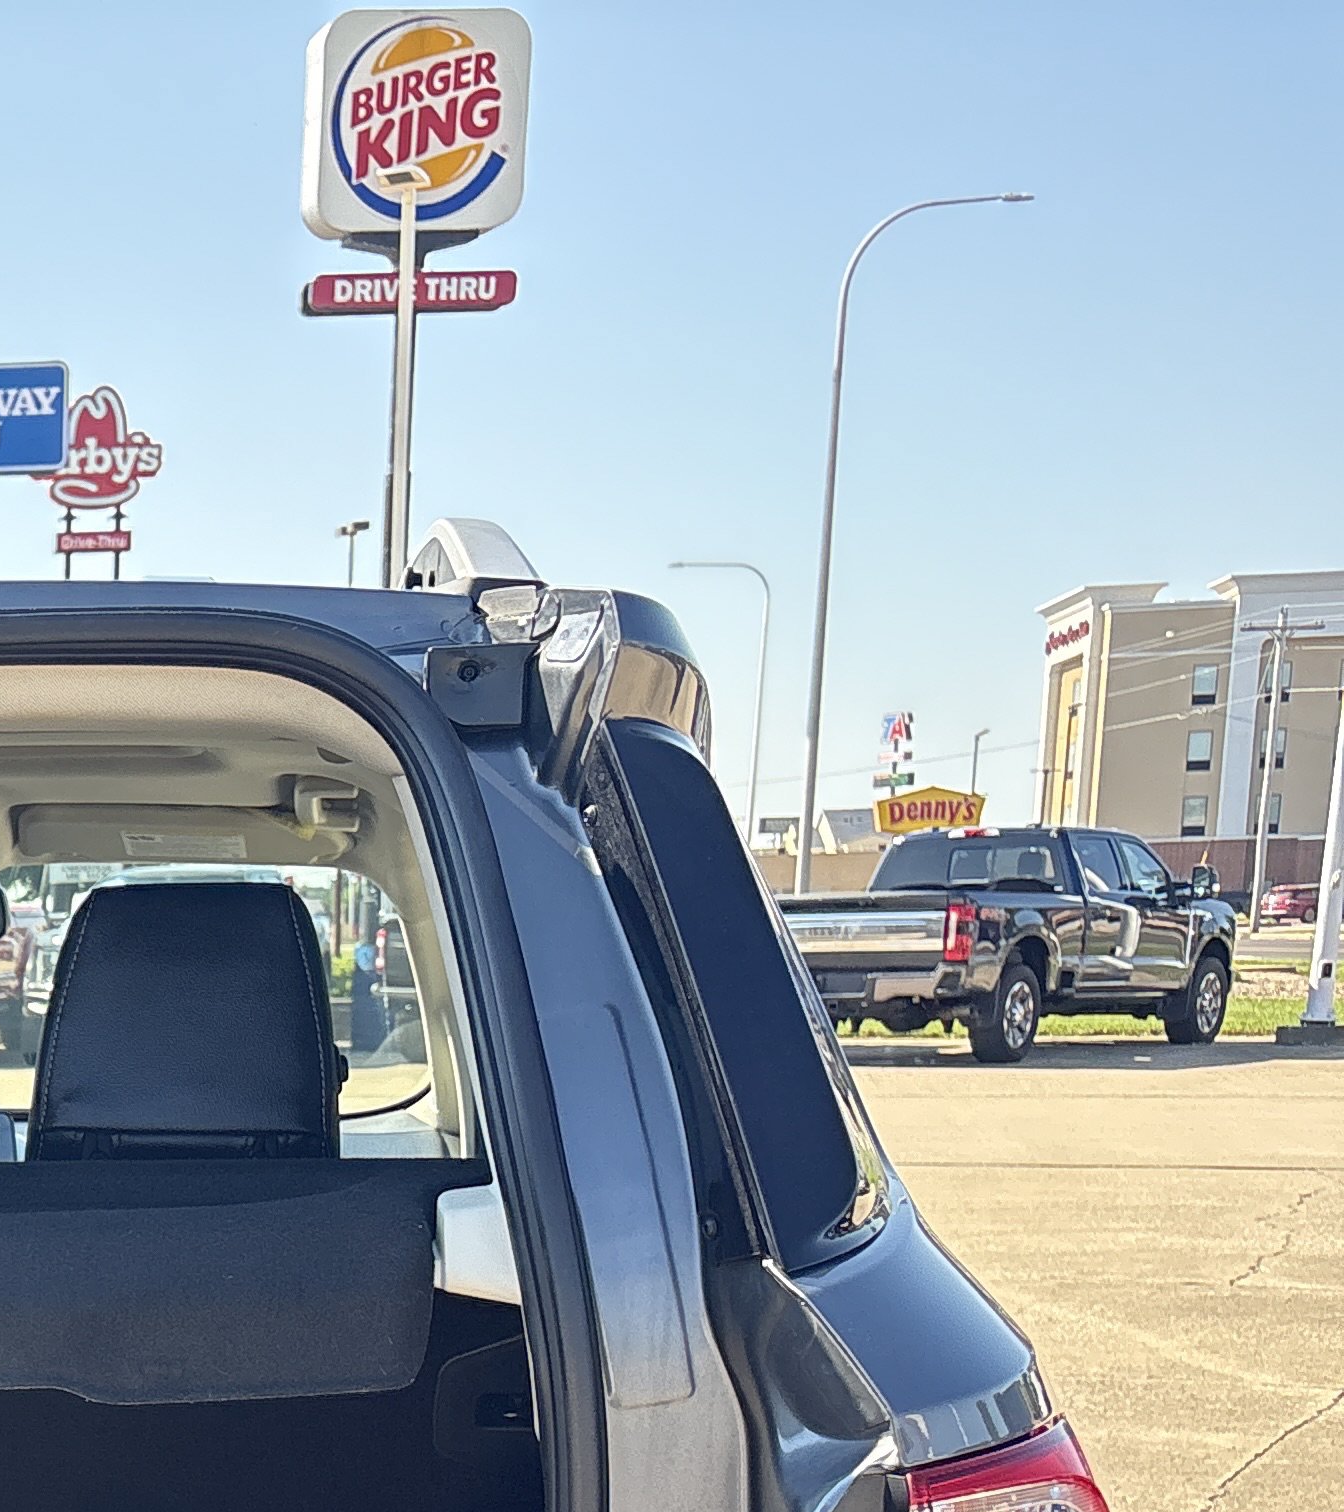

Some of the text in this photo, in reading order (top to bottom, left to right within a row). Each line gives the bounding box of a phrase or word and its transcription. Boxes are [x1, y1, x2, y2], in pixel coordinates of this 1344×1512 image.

[350, 51, 497, 130] BURGER
[355, 87, 502, 181] KING
[424, 276, 497, 301] THRU
[59, 436, 161, 484] rby's
[888, 797, 977, 826] Denny's
